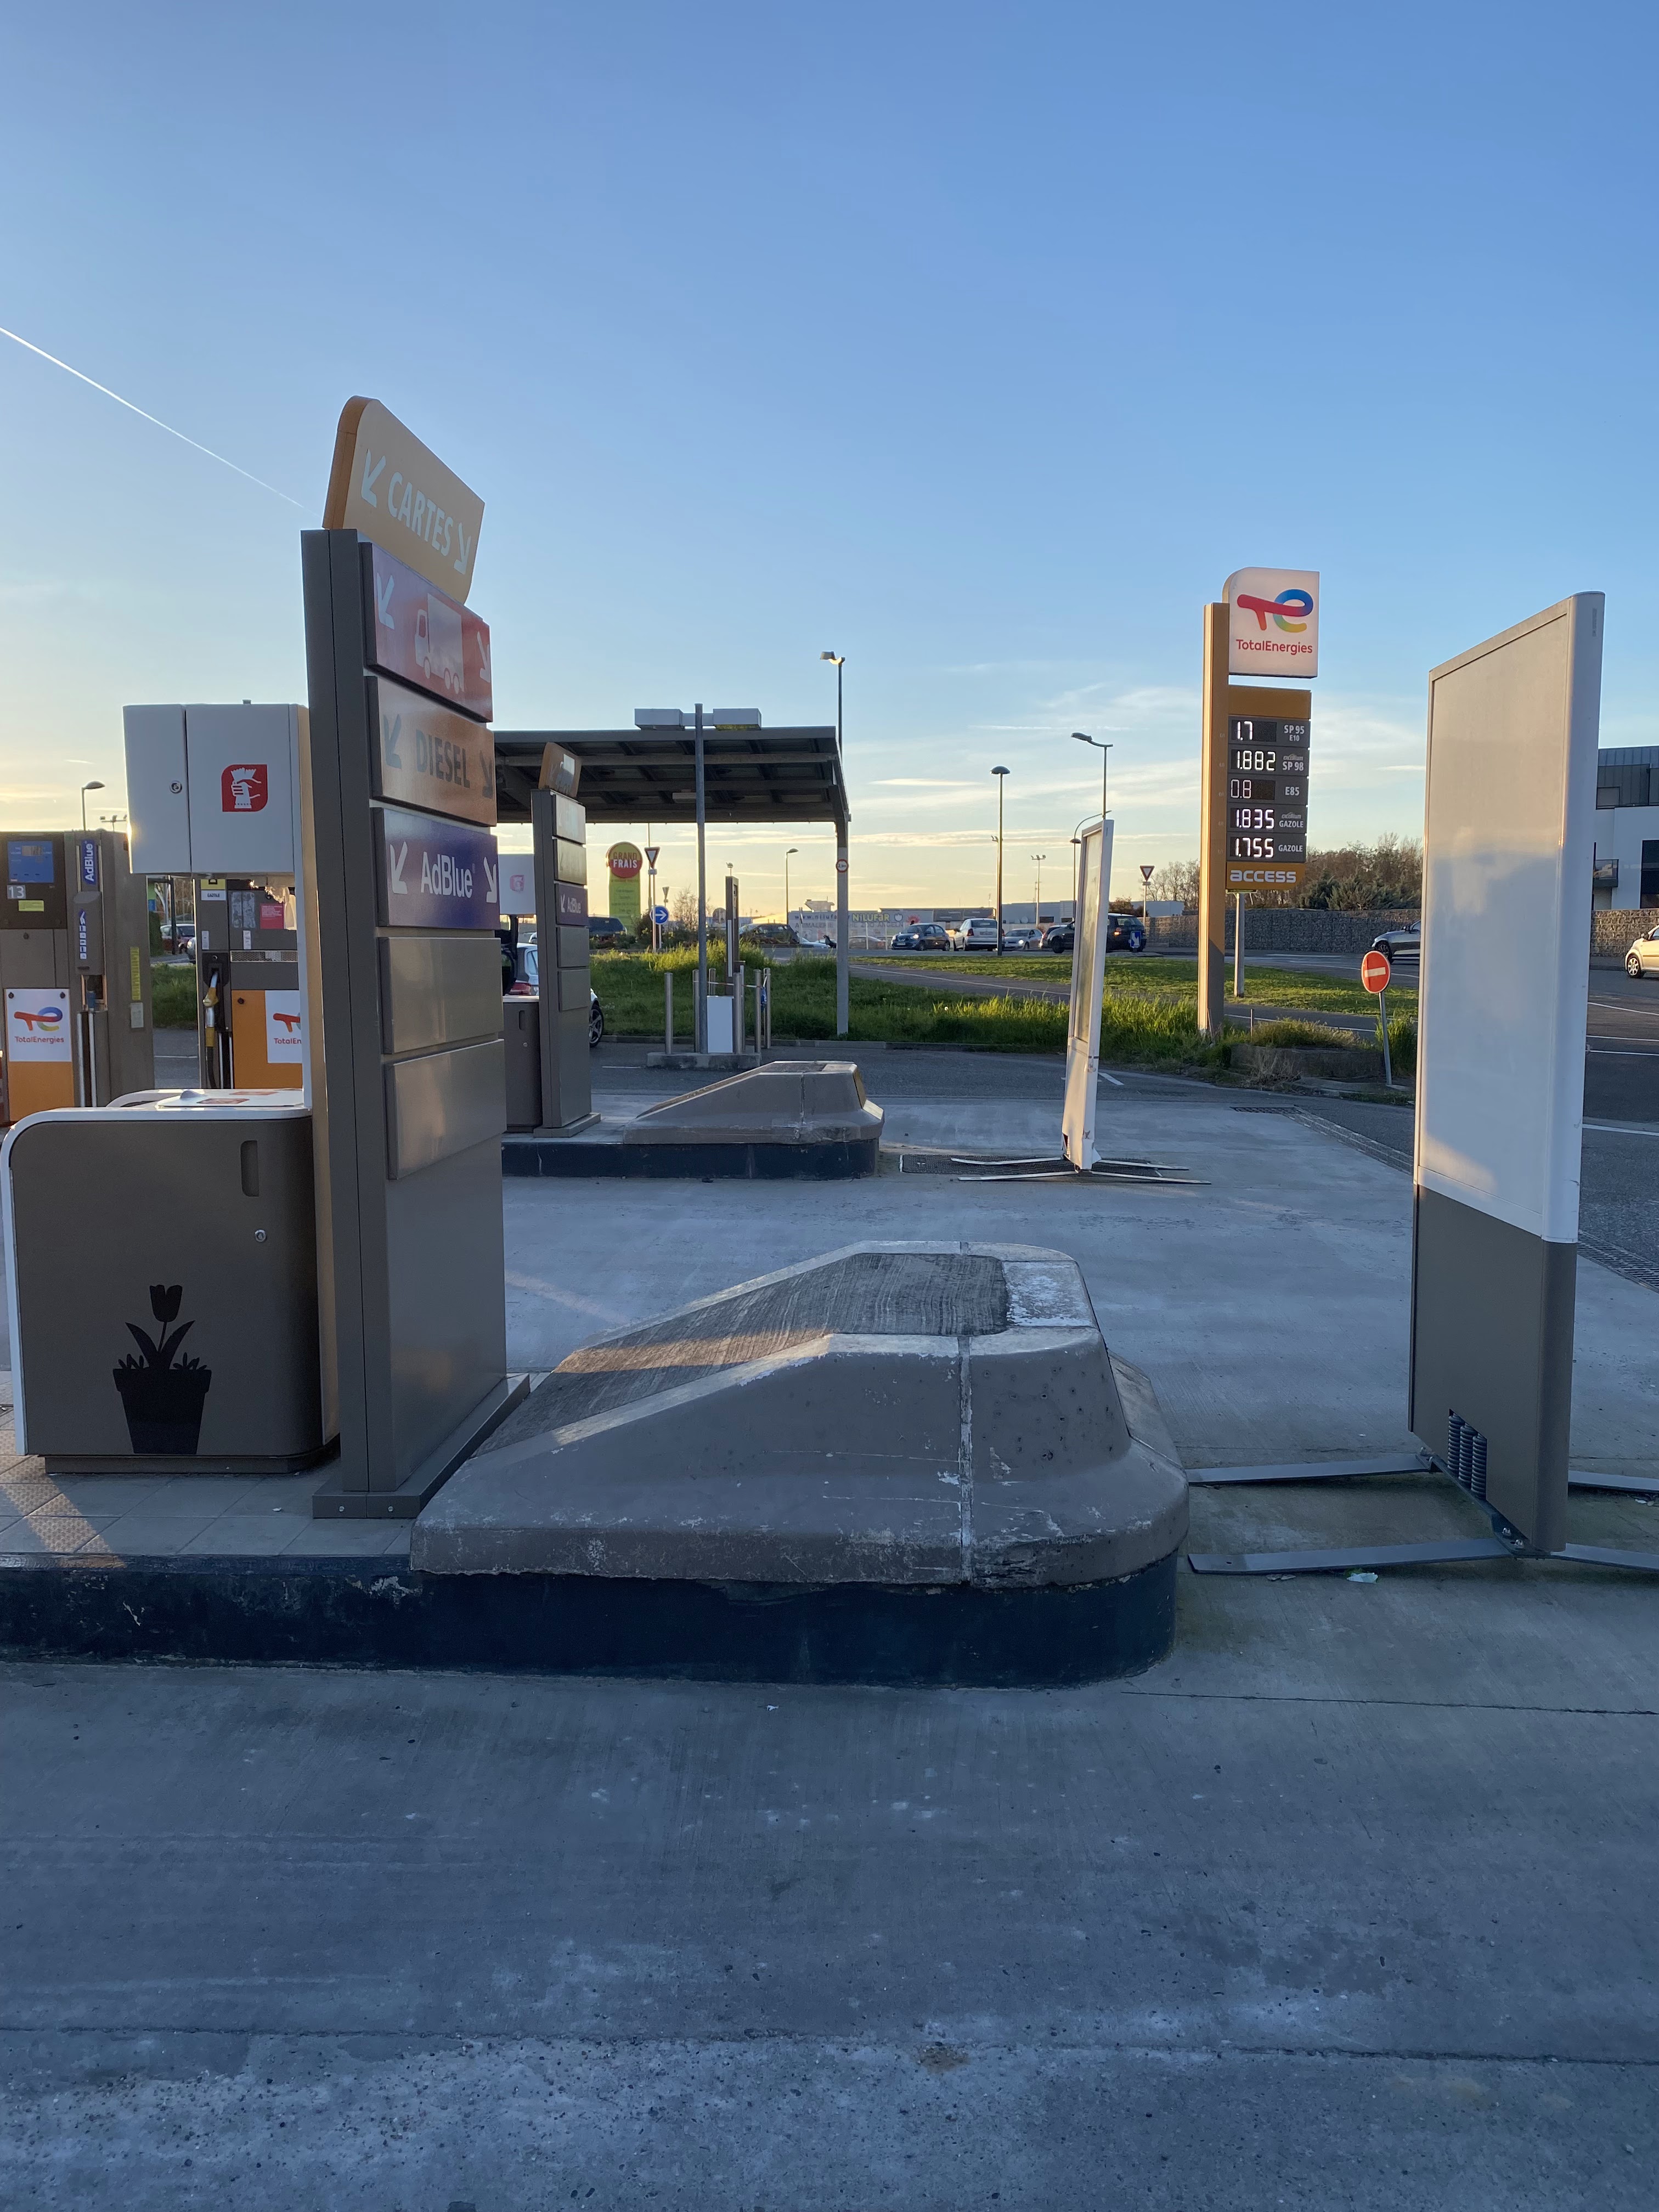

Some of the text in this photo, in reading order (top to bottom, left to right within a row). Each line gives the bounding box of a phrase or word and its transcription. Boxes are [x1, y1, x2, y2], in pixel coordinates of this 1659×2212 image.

[388, 471, 454, 556] CARTES
[1236, 639, 1313, 656] TotalEnergies
[1237, 721, 1253, 741] 1.7
[1284, 725, 1305, 735] SP 95
[416, 729, 470, 788] DIESEL
[1237, 751, 1276, 771] 1.882
[1283, 761, 1304, 771] SP 98
[1231, 779, 1251, 799] 0.8
[1285, 786, 1300, 795] E85
[1237, 809, 1274, 829] 1.835
[1235, 837, 1274, 858] 1.755
[84, 843, 94, 882] AdBlue
[613, 859, 637, 868] FRAIS
[420, 851, 473, 898] AdBlue
[9, 885, 24, 899] 13
[14, 1036, 65, 1044] TotalEnergies
